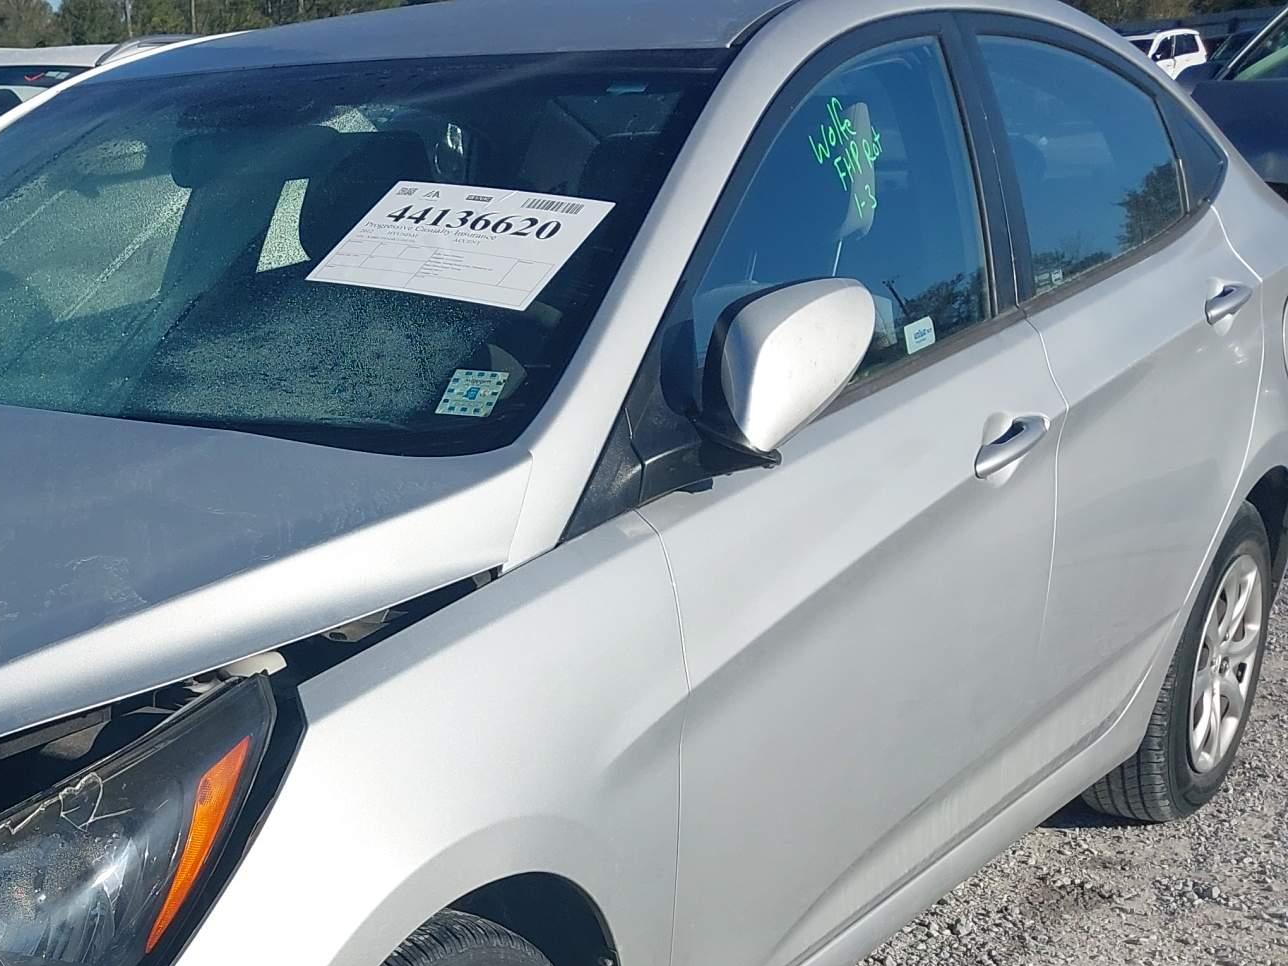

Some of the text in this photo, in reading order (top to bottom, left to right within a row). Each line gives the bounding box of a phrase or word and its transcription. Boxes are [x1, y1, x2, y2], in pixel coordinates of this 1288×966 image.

[363, 221, 414, 231] Progressive
[454, 229, 497, 241] Insurance
[387, 205, 561, 239] 44136620
